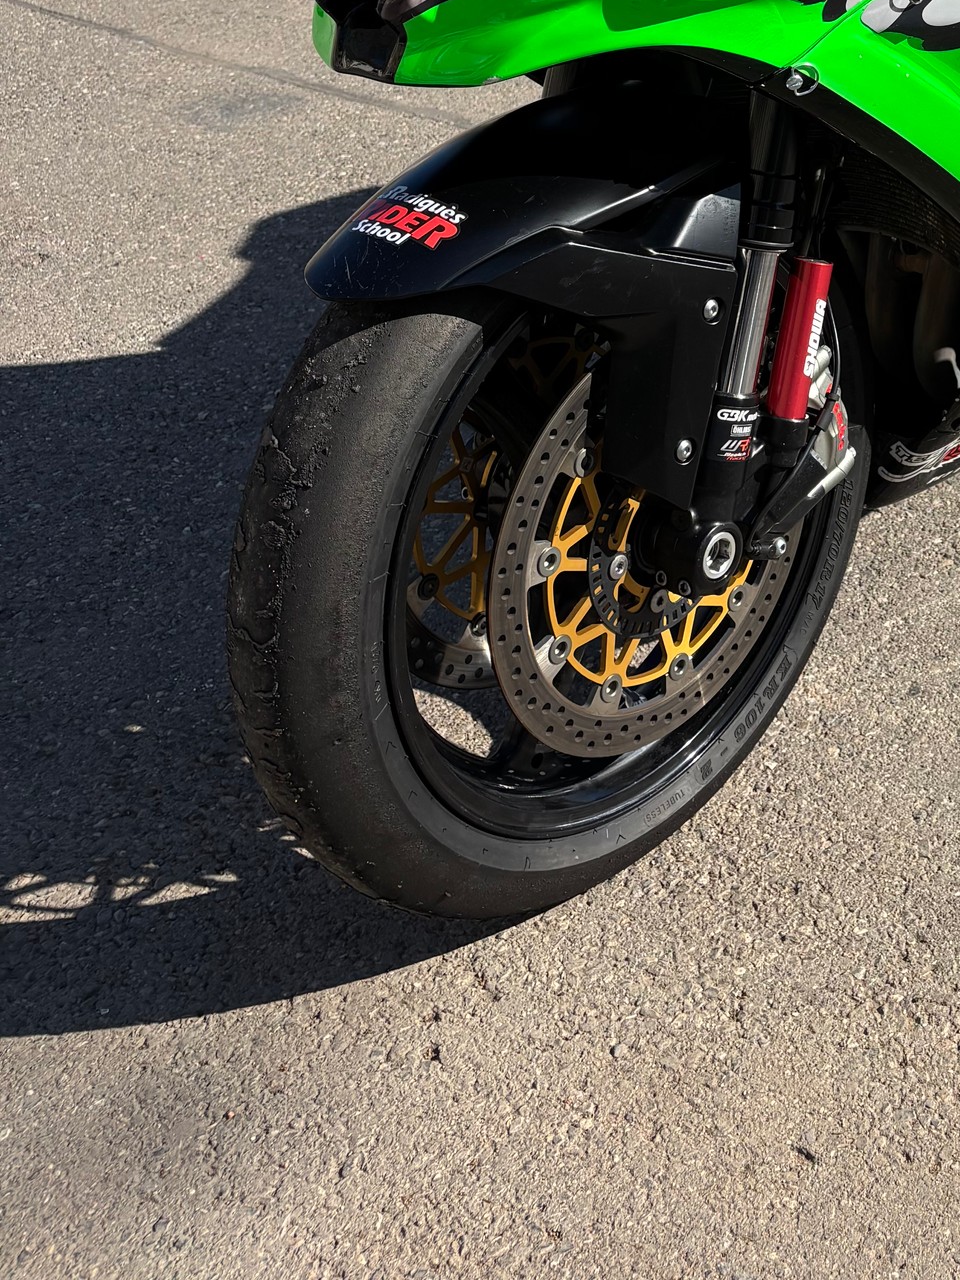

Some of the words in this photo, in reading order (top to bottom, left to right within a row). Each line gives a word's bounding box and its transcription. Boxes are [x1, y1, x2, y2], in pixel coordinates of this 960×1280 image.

[351, 219, 412, 245] School
[803, 298, 827, 379] SHOWA
[716, 408, 748, 422] GBK
[642, 787, 687, 824] TUBELESS
